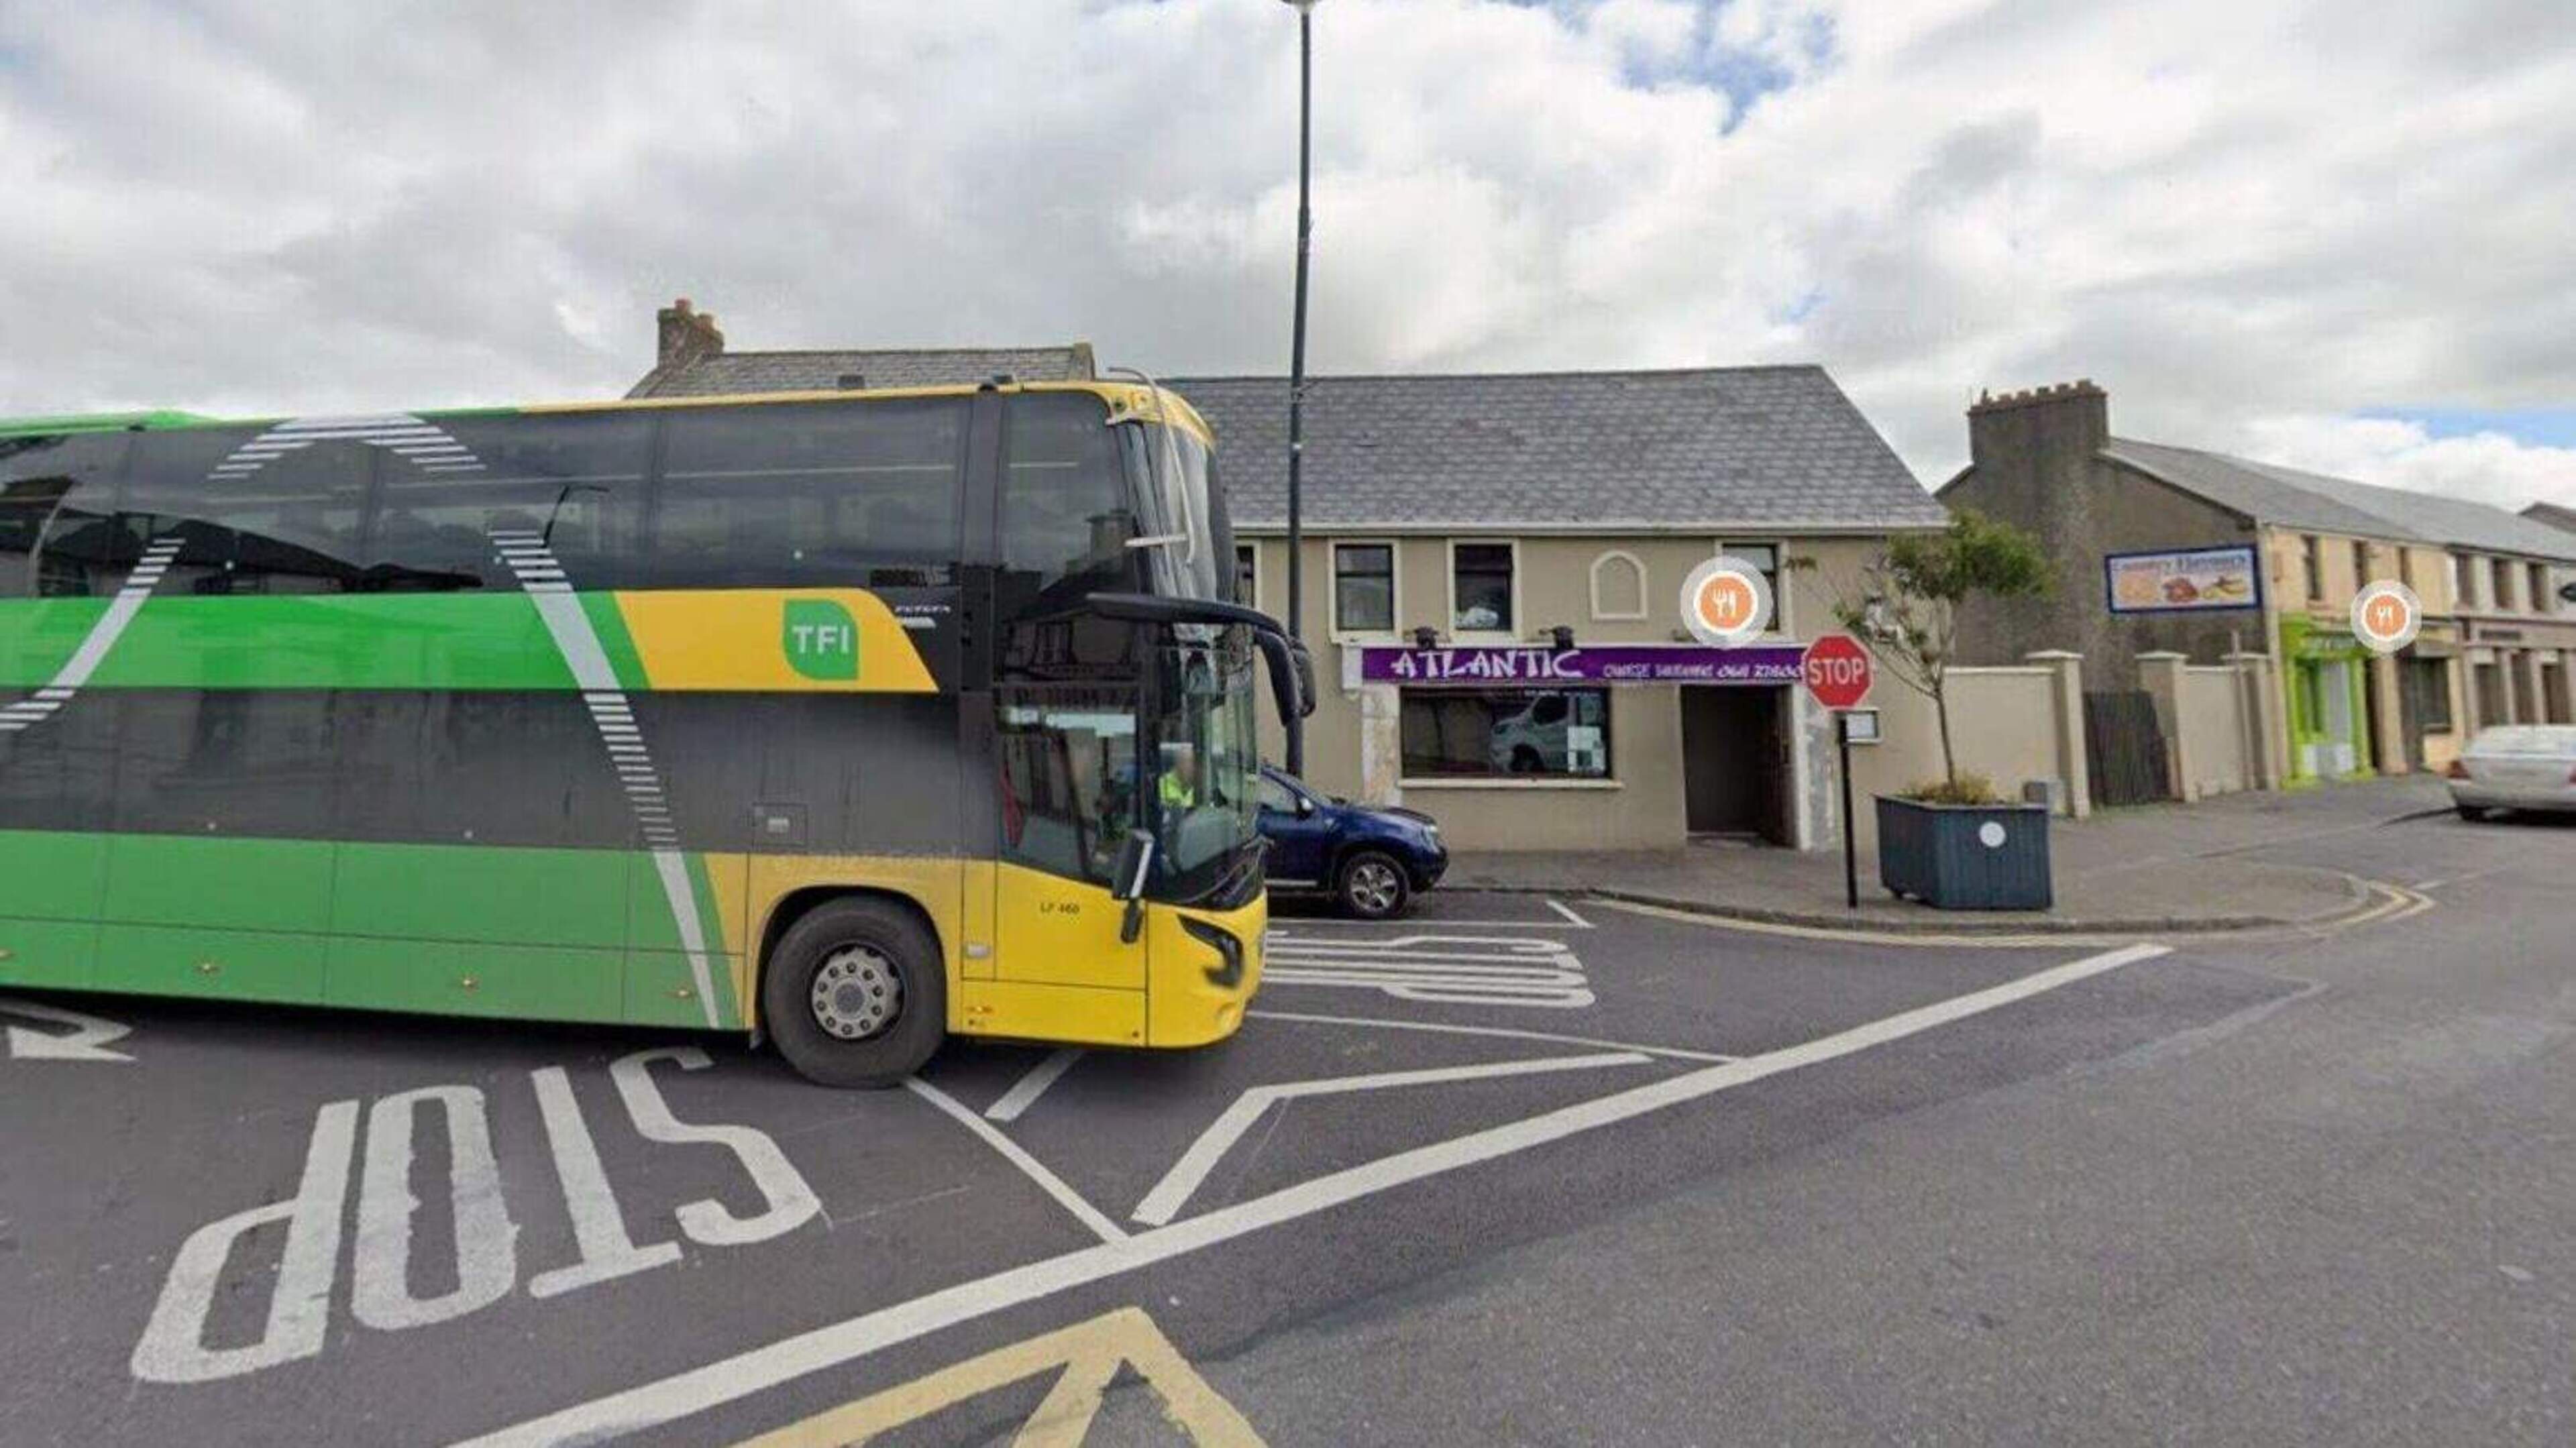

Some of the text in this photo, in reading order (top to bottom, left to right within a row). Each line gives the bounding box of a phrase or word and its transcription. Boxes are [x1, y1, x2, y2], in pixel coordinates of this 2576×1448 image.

[792, 625, 848, 653] TFI
[1391, 650, 1585, 678] ATLANTIC
[1809, 658, 1865, 685] STOP
[131, 1047, 822, 1383] STOP
